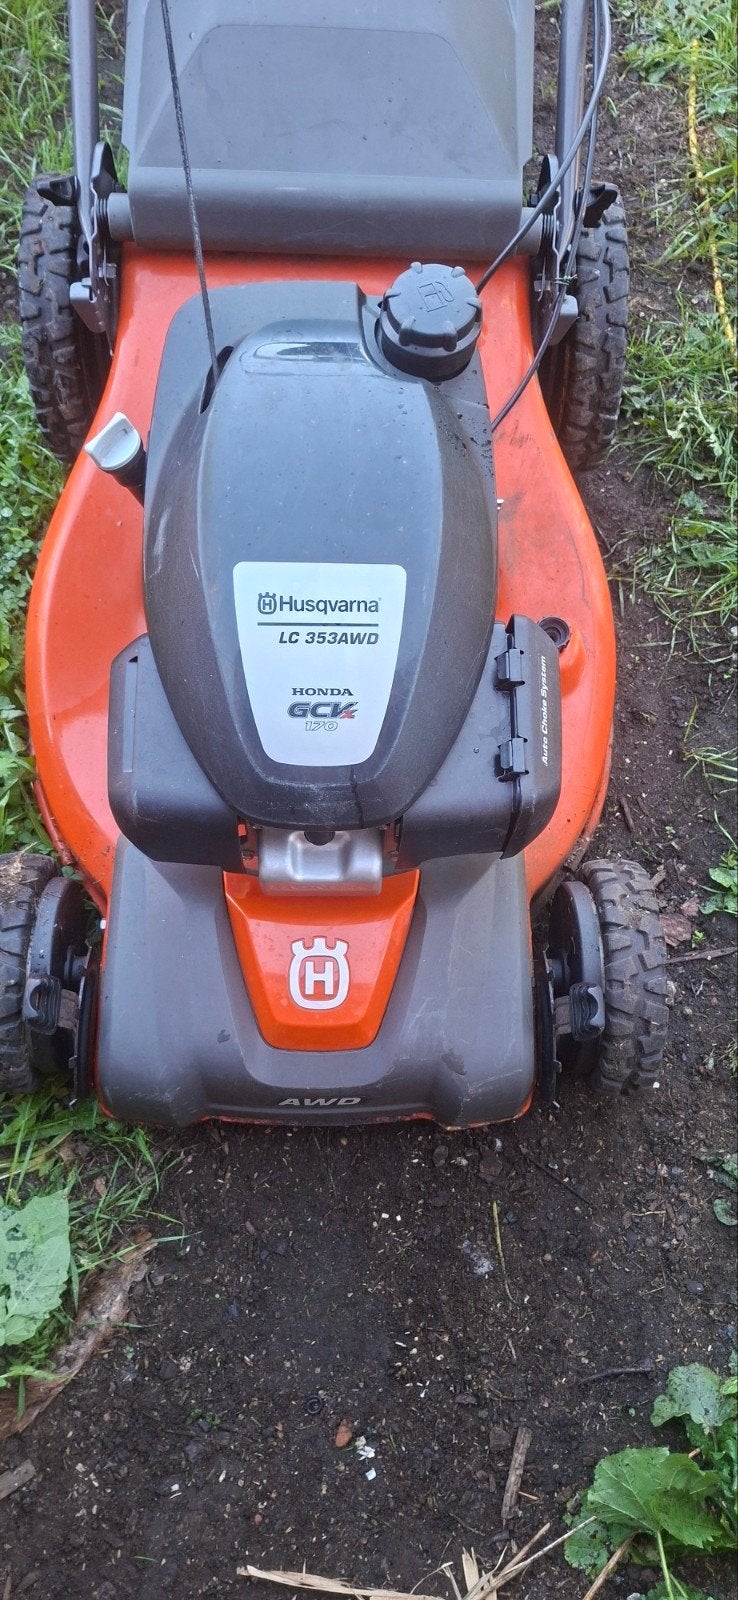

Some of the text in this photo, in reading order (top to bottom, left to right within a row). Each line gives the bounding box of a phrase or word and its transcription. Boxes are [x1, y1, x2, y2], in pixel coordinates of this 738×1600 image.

[279, 595, 380, 614] Husqvarna
[279, 632, 379, 644] LC 353AWD
[292, 688, 353, 696] HONDA
[540, 655, 549, 766] Auto Choke System
[305, 721, 338, 731] 170
[305, 961, 334, 995] H
[278, 1098, 361, 1106] AWD
